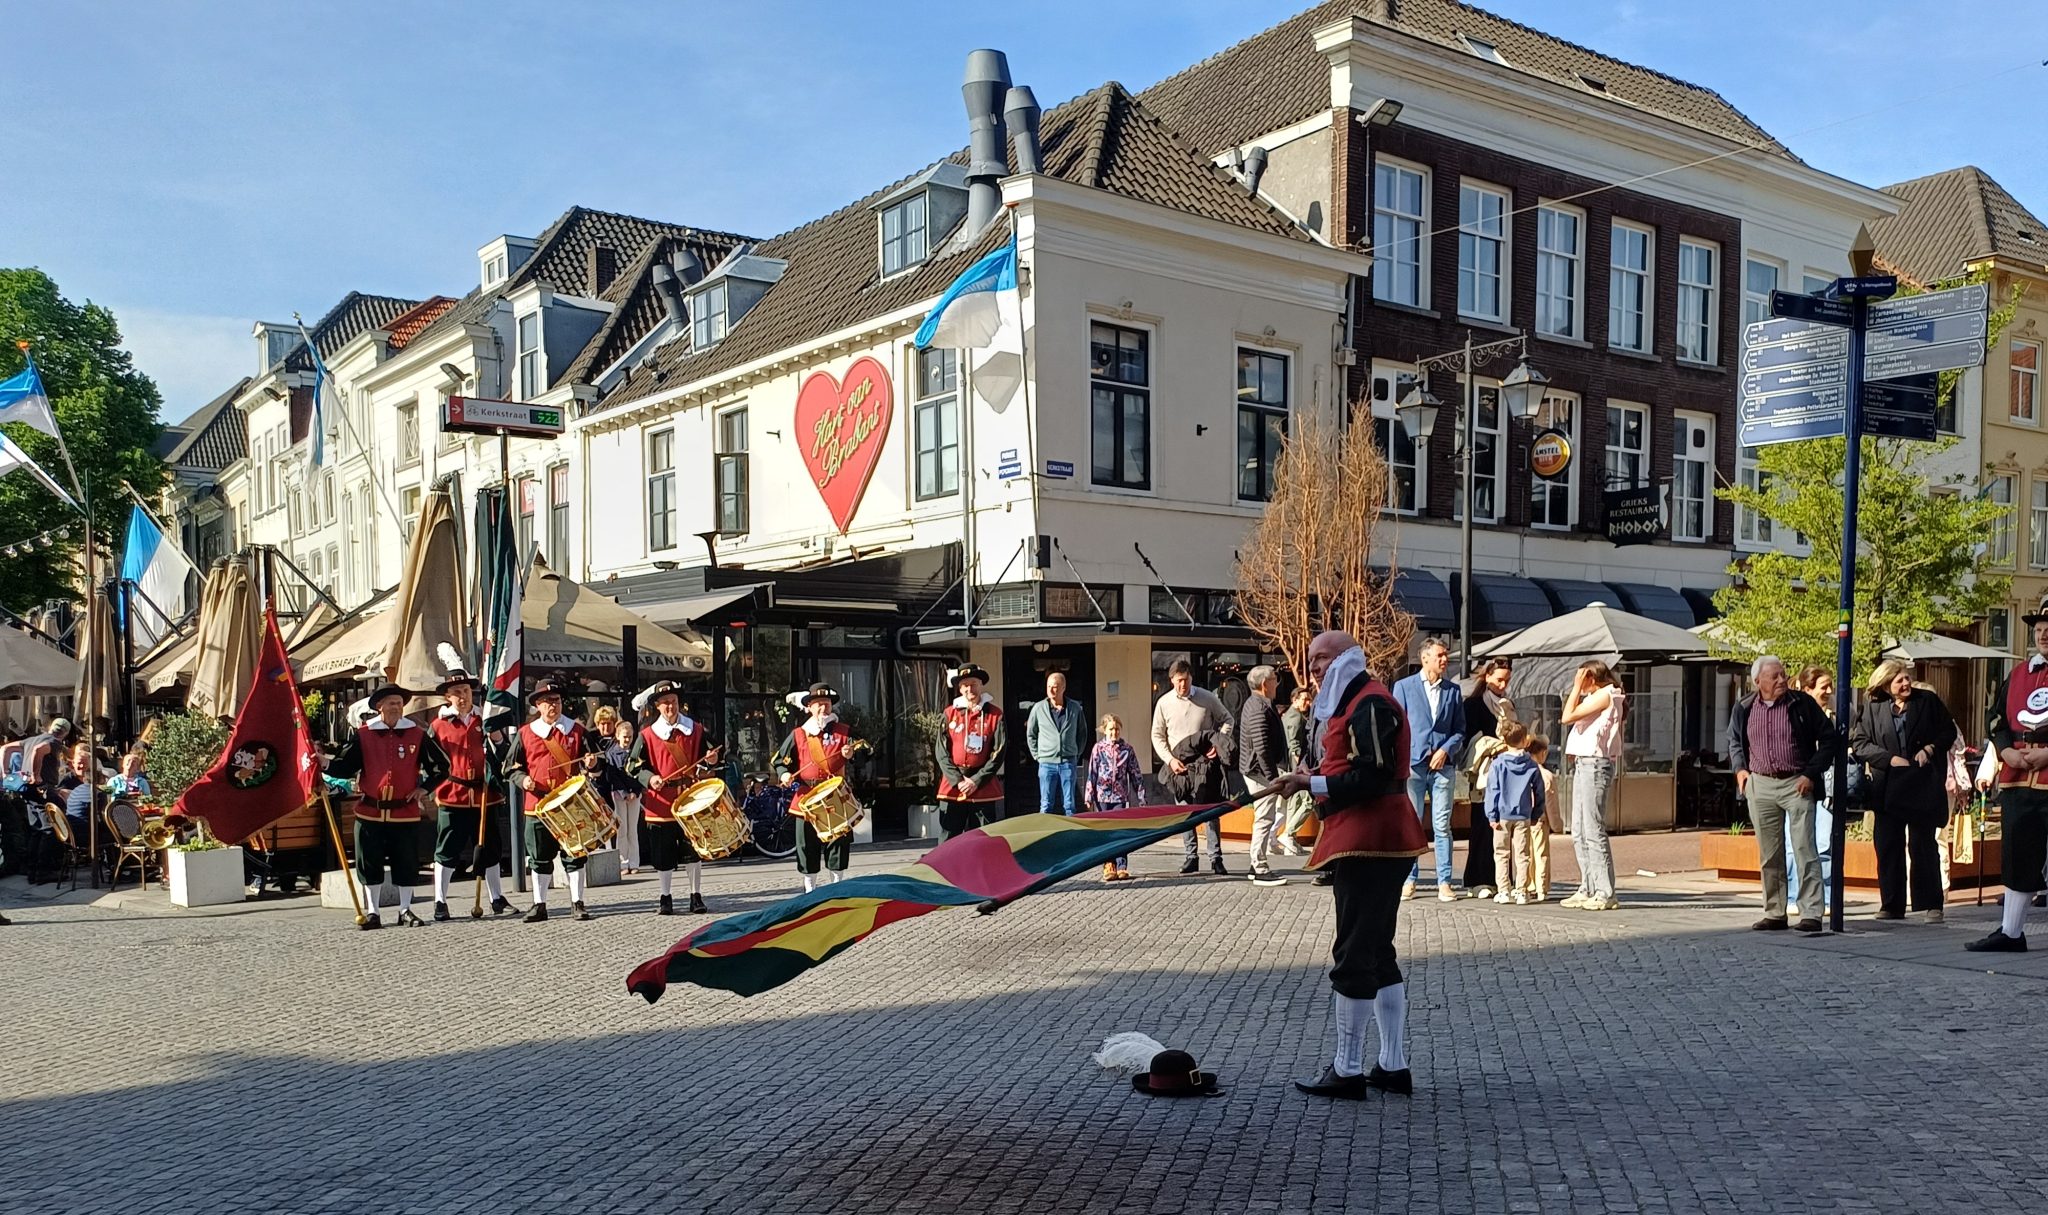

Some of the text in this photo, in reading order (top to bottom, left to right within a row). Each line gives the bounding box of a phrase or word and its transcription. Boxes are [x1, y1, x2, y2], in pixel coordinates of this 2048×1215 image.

[480, 408, 528, 420] Kerkstraat
[811, 376, 873, 458] Hart van
[819, 400, 881, 488] Brabant
[1535, 446, 1559, 456] AMSTEL
[1620, 497, 1648, 508] GRIEKS
[1609, 504, 1660, 518] RESTAURANT
[1608, 517, 1660, 537] RHODOS
[530, 653, 572, 664] HART
[577, 653, 610, 664] VAN
[304, 655, 362, 677] HART VAN BRABANT
